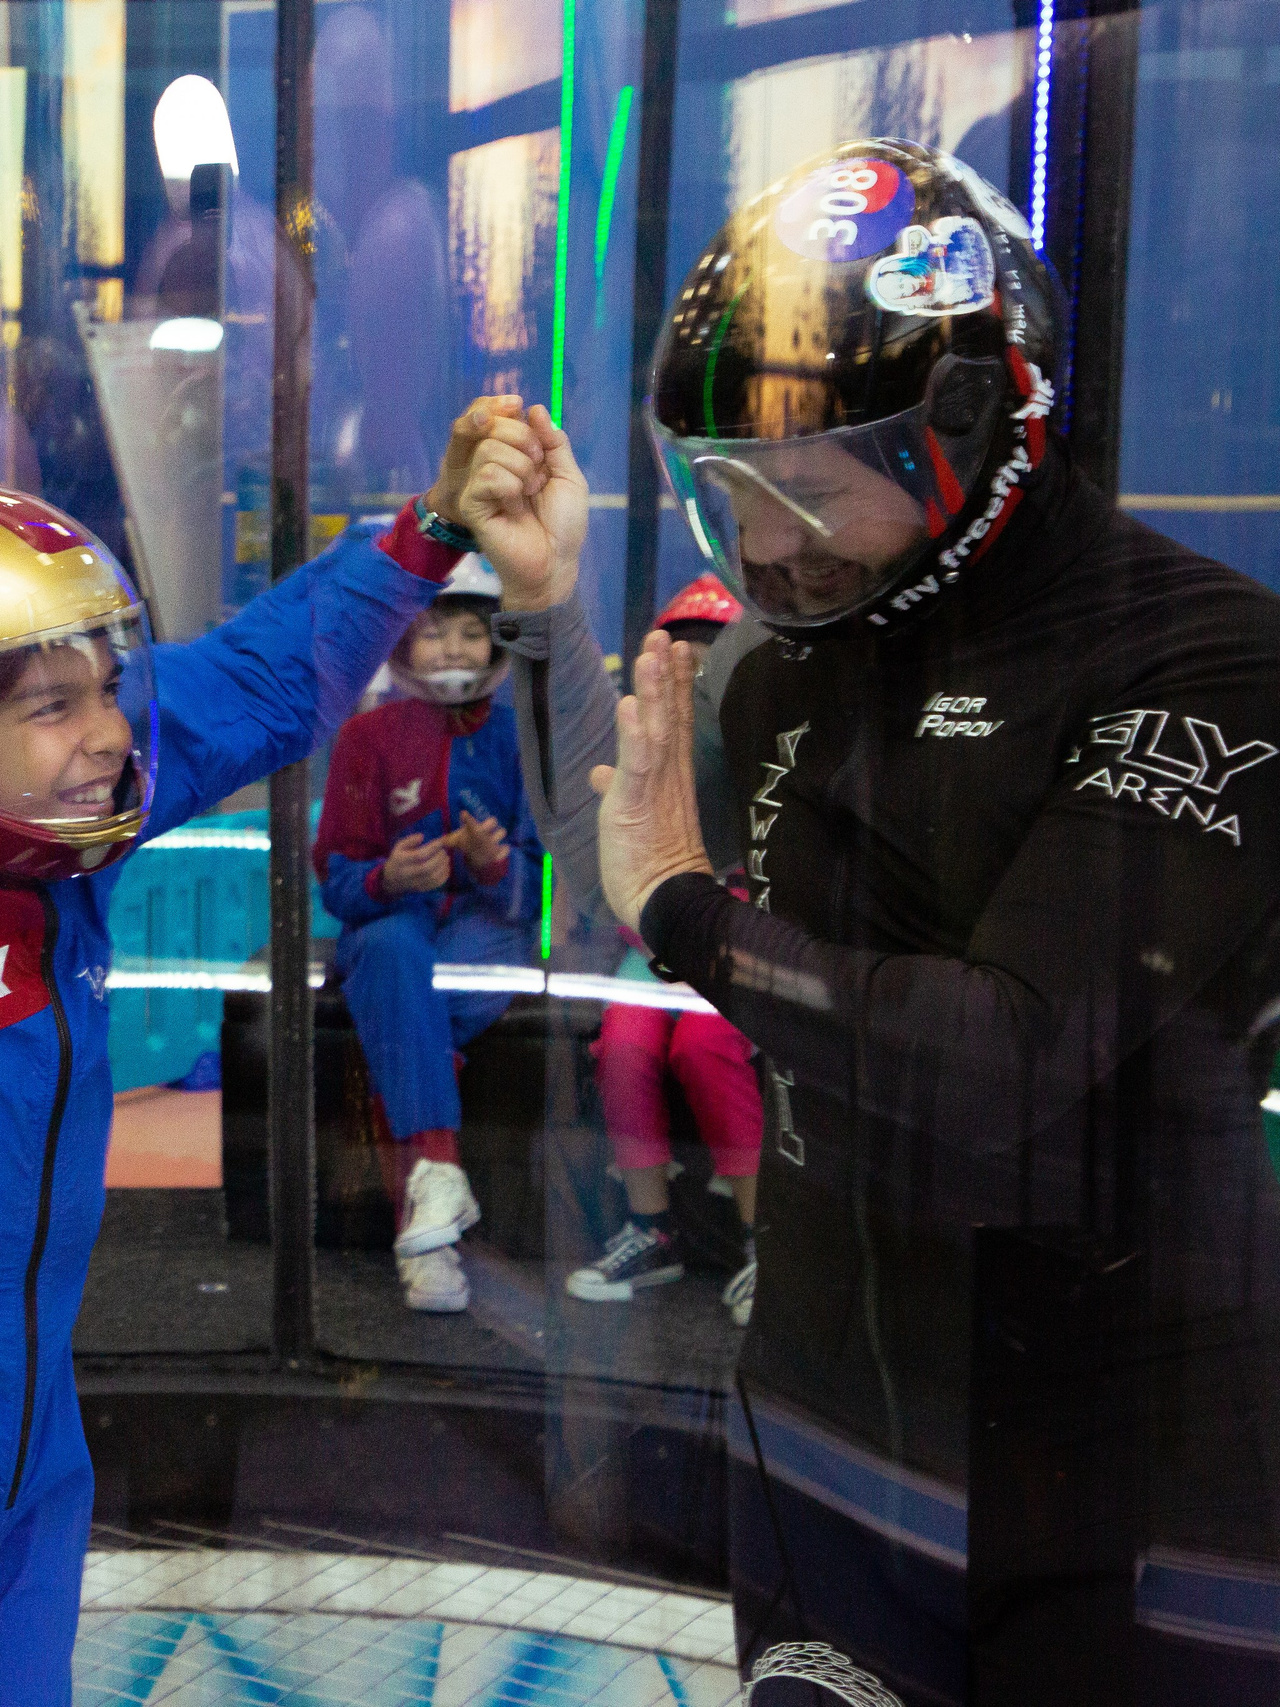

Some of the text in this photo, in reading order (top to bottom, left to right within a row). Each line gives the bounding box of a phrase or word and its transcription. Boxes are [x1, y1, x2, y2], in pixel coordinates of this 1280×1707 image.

[810, 169, 878, 246] 308
[922, 692, 987, 713] IGOR
[914, 714, 1005, 737] POPOV
